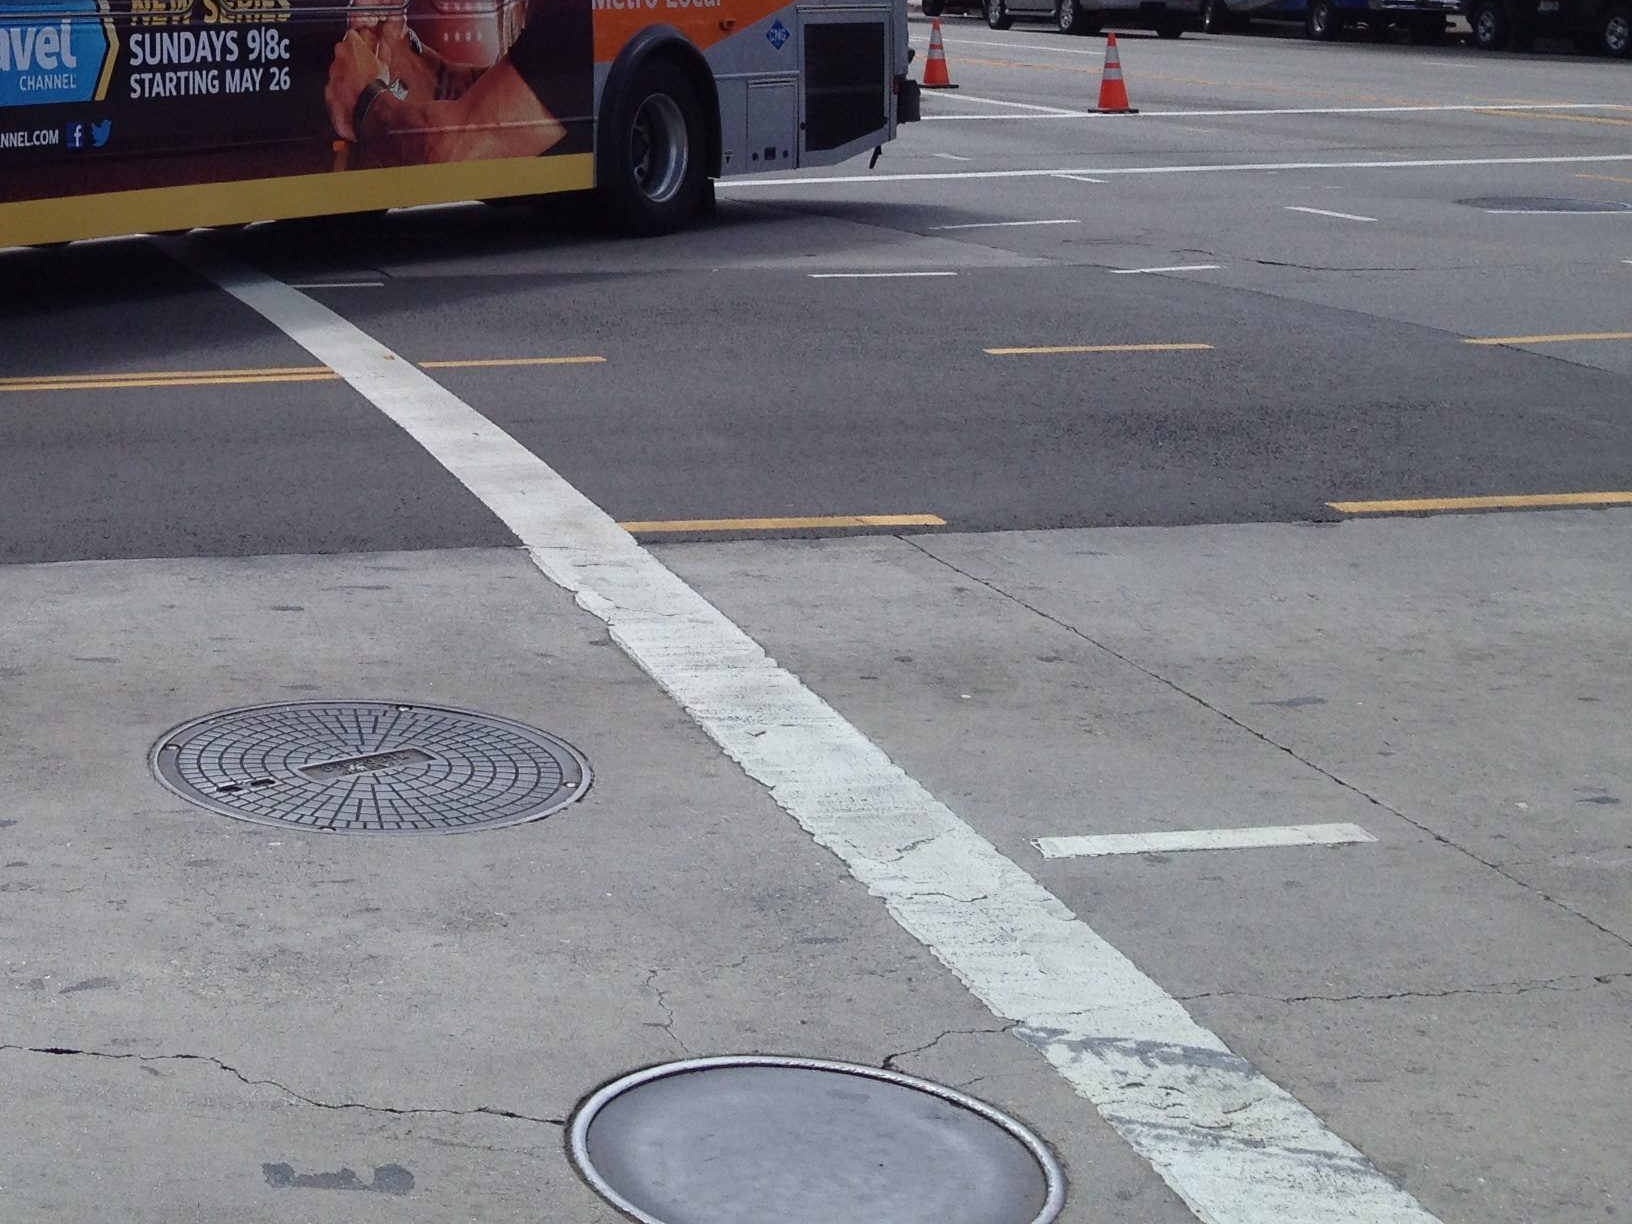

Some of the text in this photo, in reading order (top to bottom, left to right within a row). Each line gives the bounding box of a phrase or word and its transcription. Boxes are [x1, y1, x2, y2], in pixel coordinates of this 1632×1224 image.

[129, 29, 239, 66] SUNDAYS
[769, 29, 788, 43] CNG
[19, 73, 77, 92] CHANNEL
[129, 66, 291, 99] STARTING MAY 26
